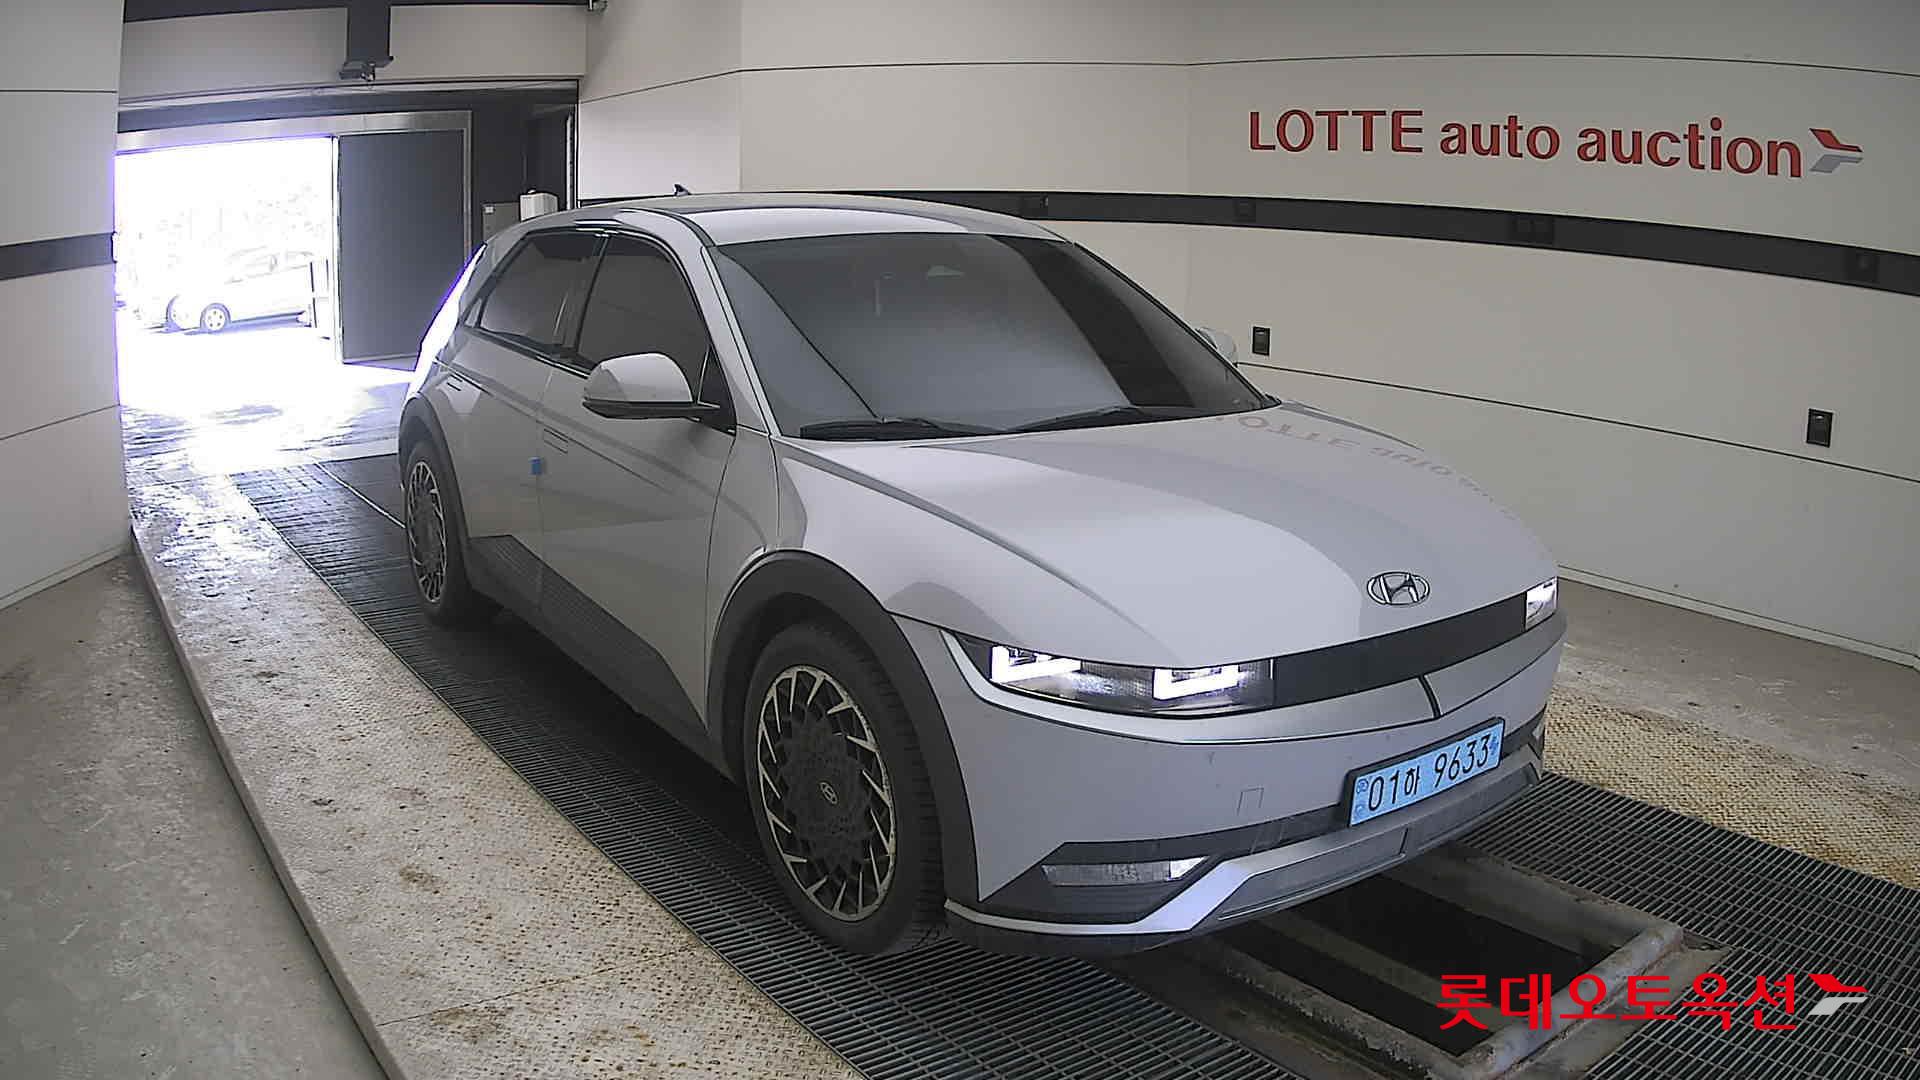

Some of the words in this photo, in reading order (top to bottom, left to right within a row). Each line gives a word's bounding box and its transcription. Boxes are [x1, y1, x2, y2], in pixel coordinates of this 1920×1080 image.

[1249, 109, 1424, 153] LOTTE
[1439, 115, 1560, 161] auto
[1576, 117, 1803, 178] auction
[1368, 765, 1420, 812] 01하
[1434, 734, 1491, 788] 9633
